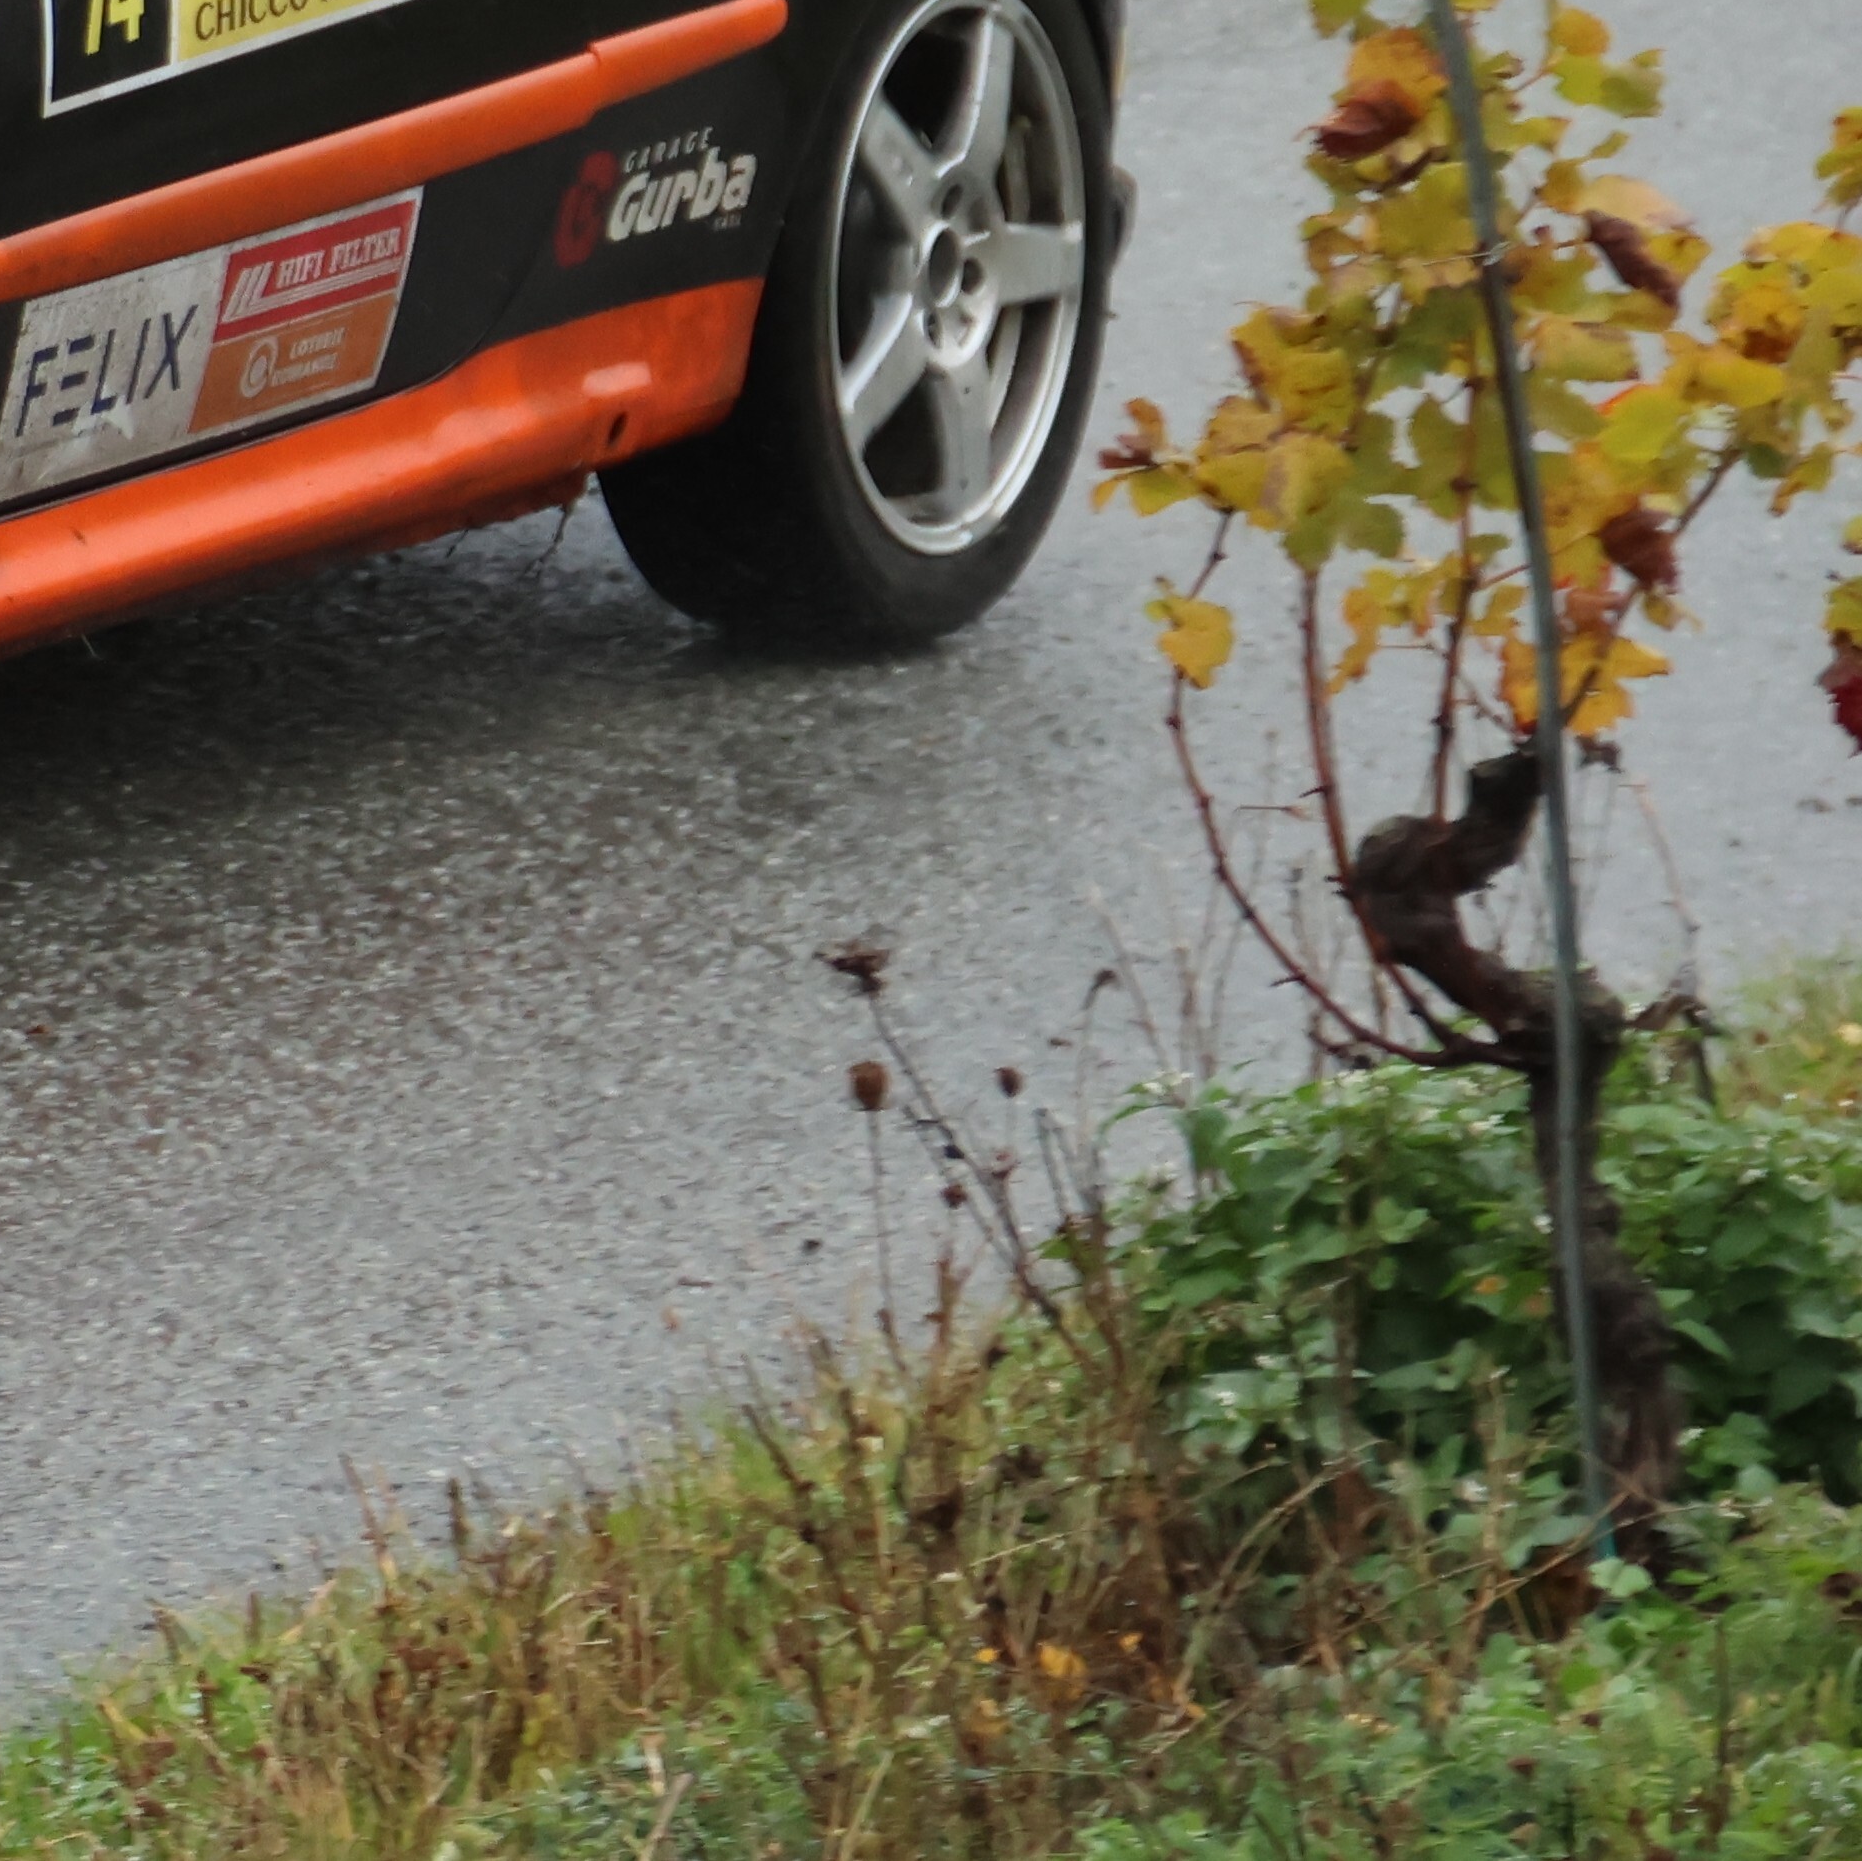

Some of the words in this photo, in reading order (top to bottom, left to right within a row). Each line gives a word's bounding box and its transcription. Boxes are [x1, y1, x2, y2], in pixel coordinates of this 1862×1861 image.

[606, 145, 757, 242] Gurba
[623, 126, 713, 174] GARAGE
[14, 303, 199, 438] FELIX
